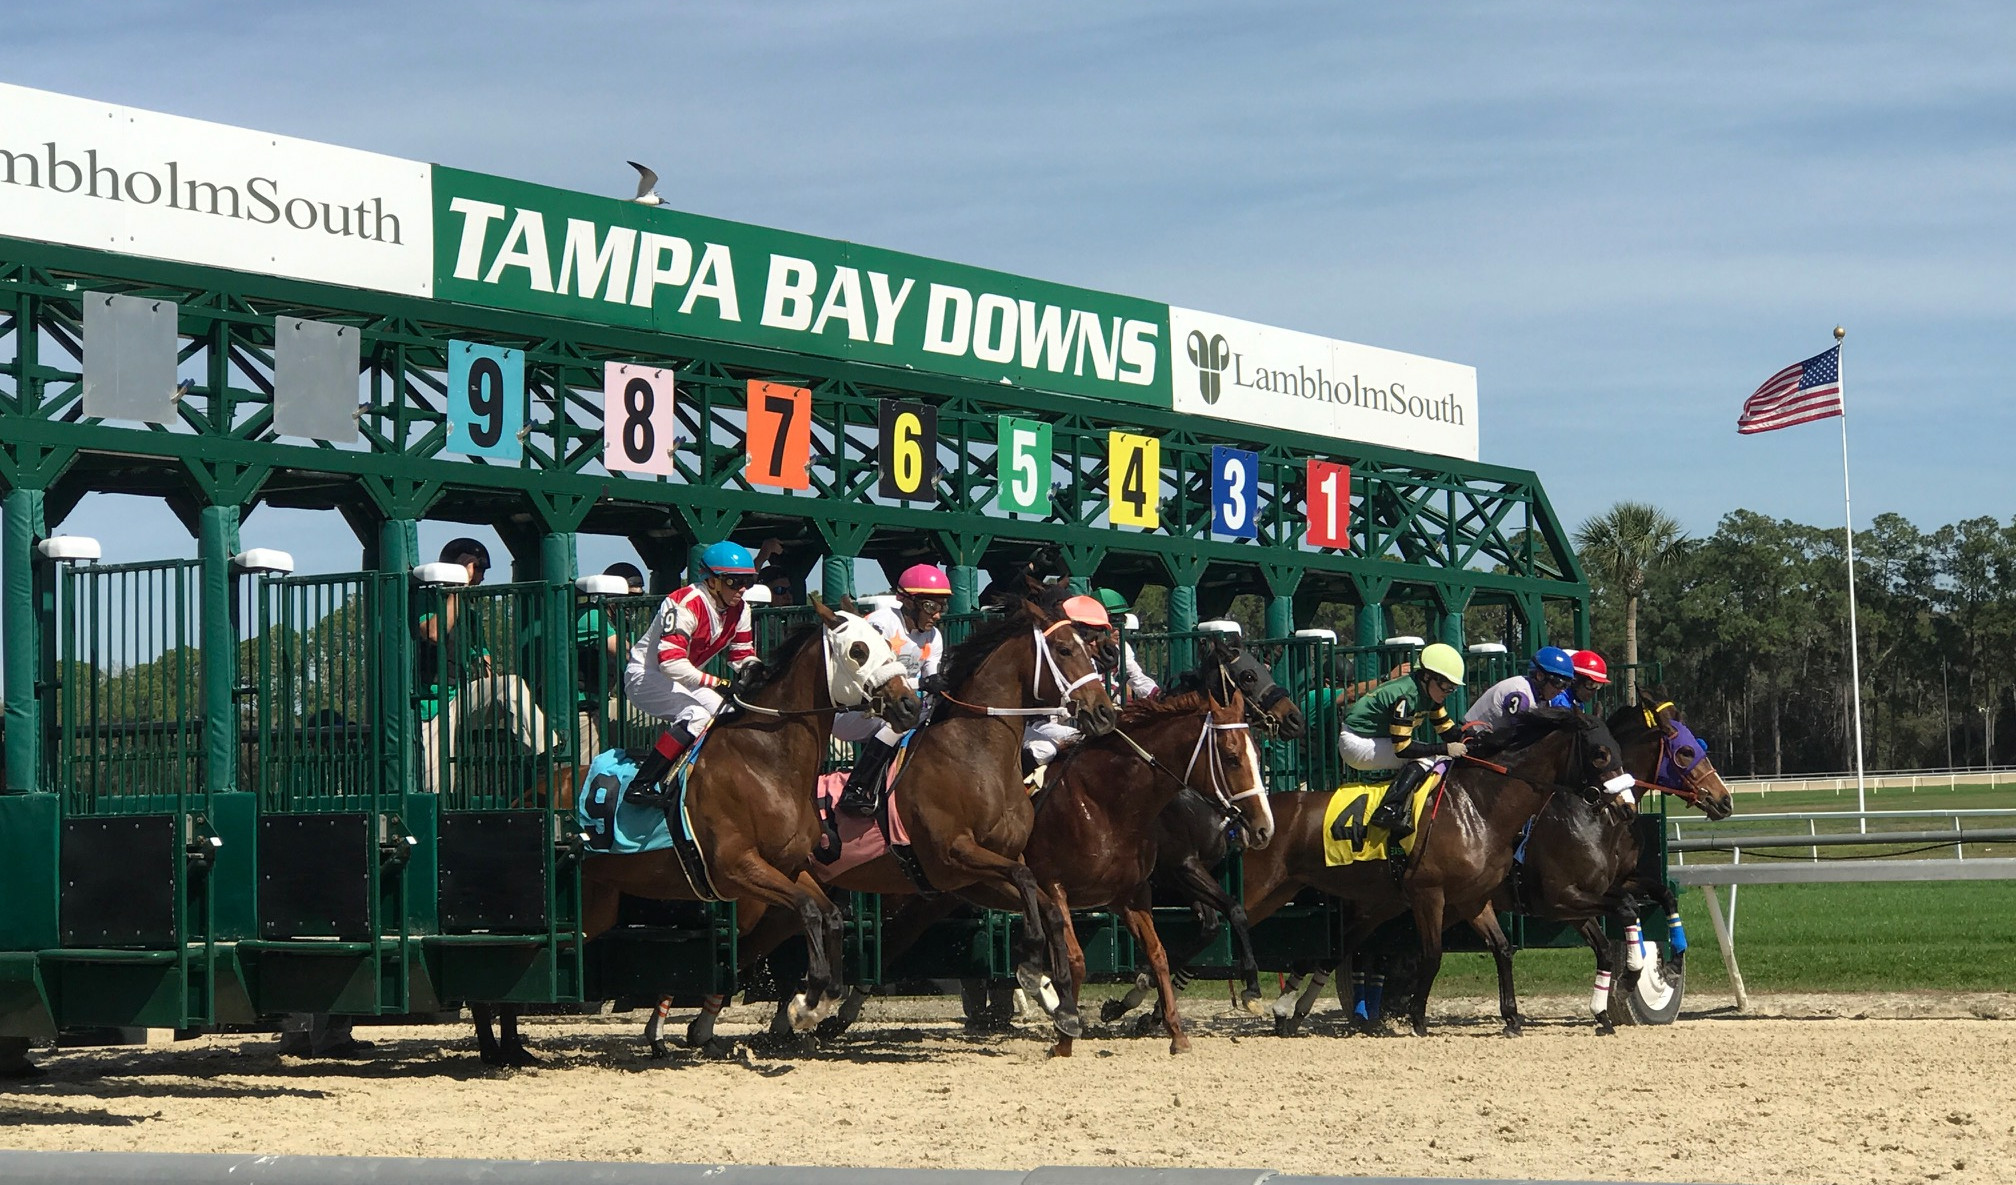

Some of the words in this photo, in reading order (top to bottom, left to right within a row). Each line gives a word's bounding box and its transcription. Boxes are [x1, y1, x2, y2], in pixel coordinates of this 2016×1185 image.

[449, 196, 742, 322] TAMPA
[759, 253, 916, 346] BAY
[922, 282, 1160, 387] DOWNS
[468, 357, 503, 448] 9
[623, 377, 655, 464] 8
[1233, 352, 1464, 426] LambholmSouth
[764, 396, 794, 477] 7
[893, 412, 923, 493] 6
[1011, 428, 1037, 507] 5
[1121, 446, 1147, 518] 4
[1223, 458, 1246, 530] 3
[1320, 471, 1337, 541] 1
[664, 612, 675, 633] 9
[1395, 699, 1406, 718] 4
[1508, 697, 1520, 714] 3
[584, 773, 622, 850] 9
[1330, 793, 1369, 853] 4
